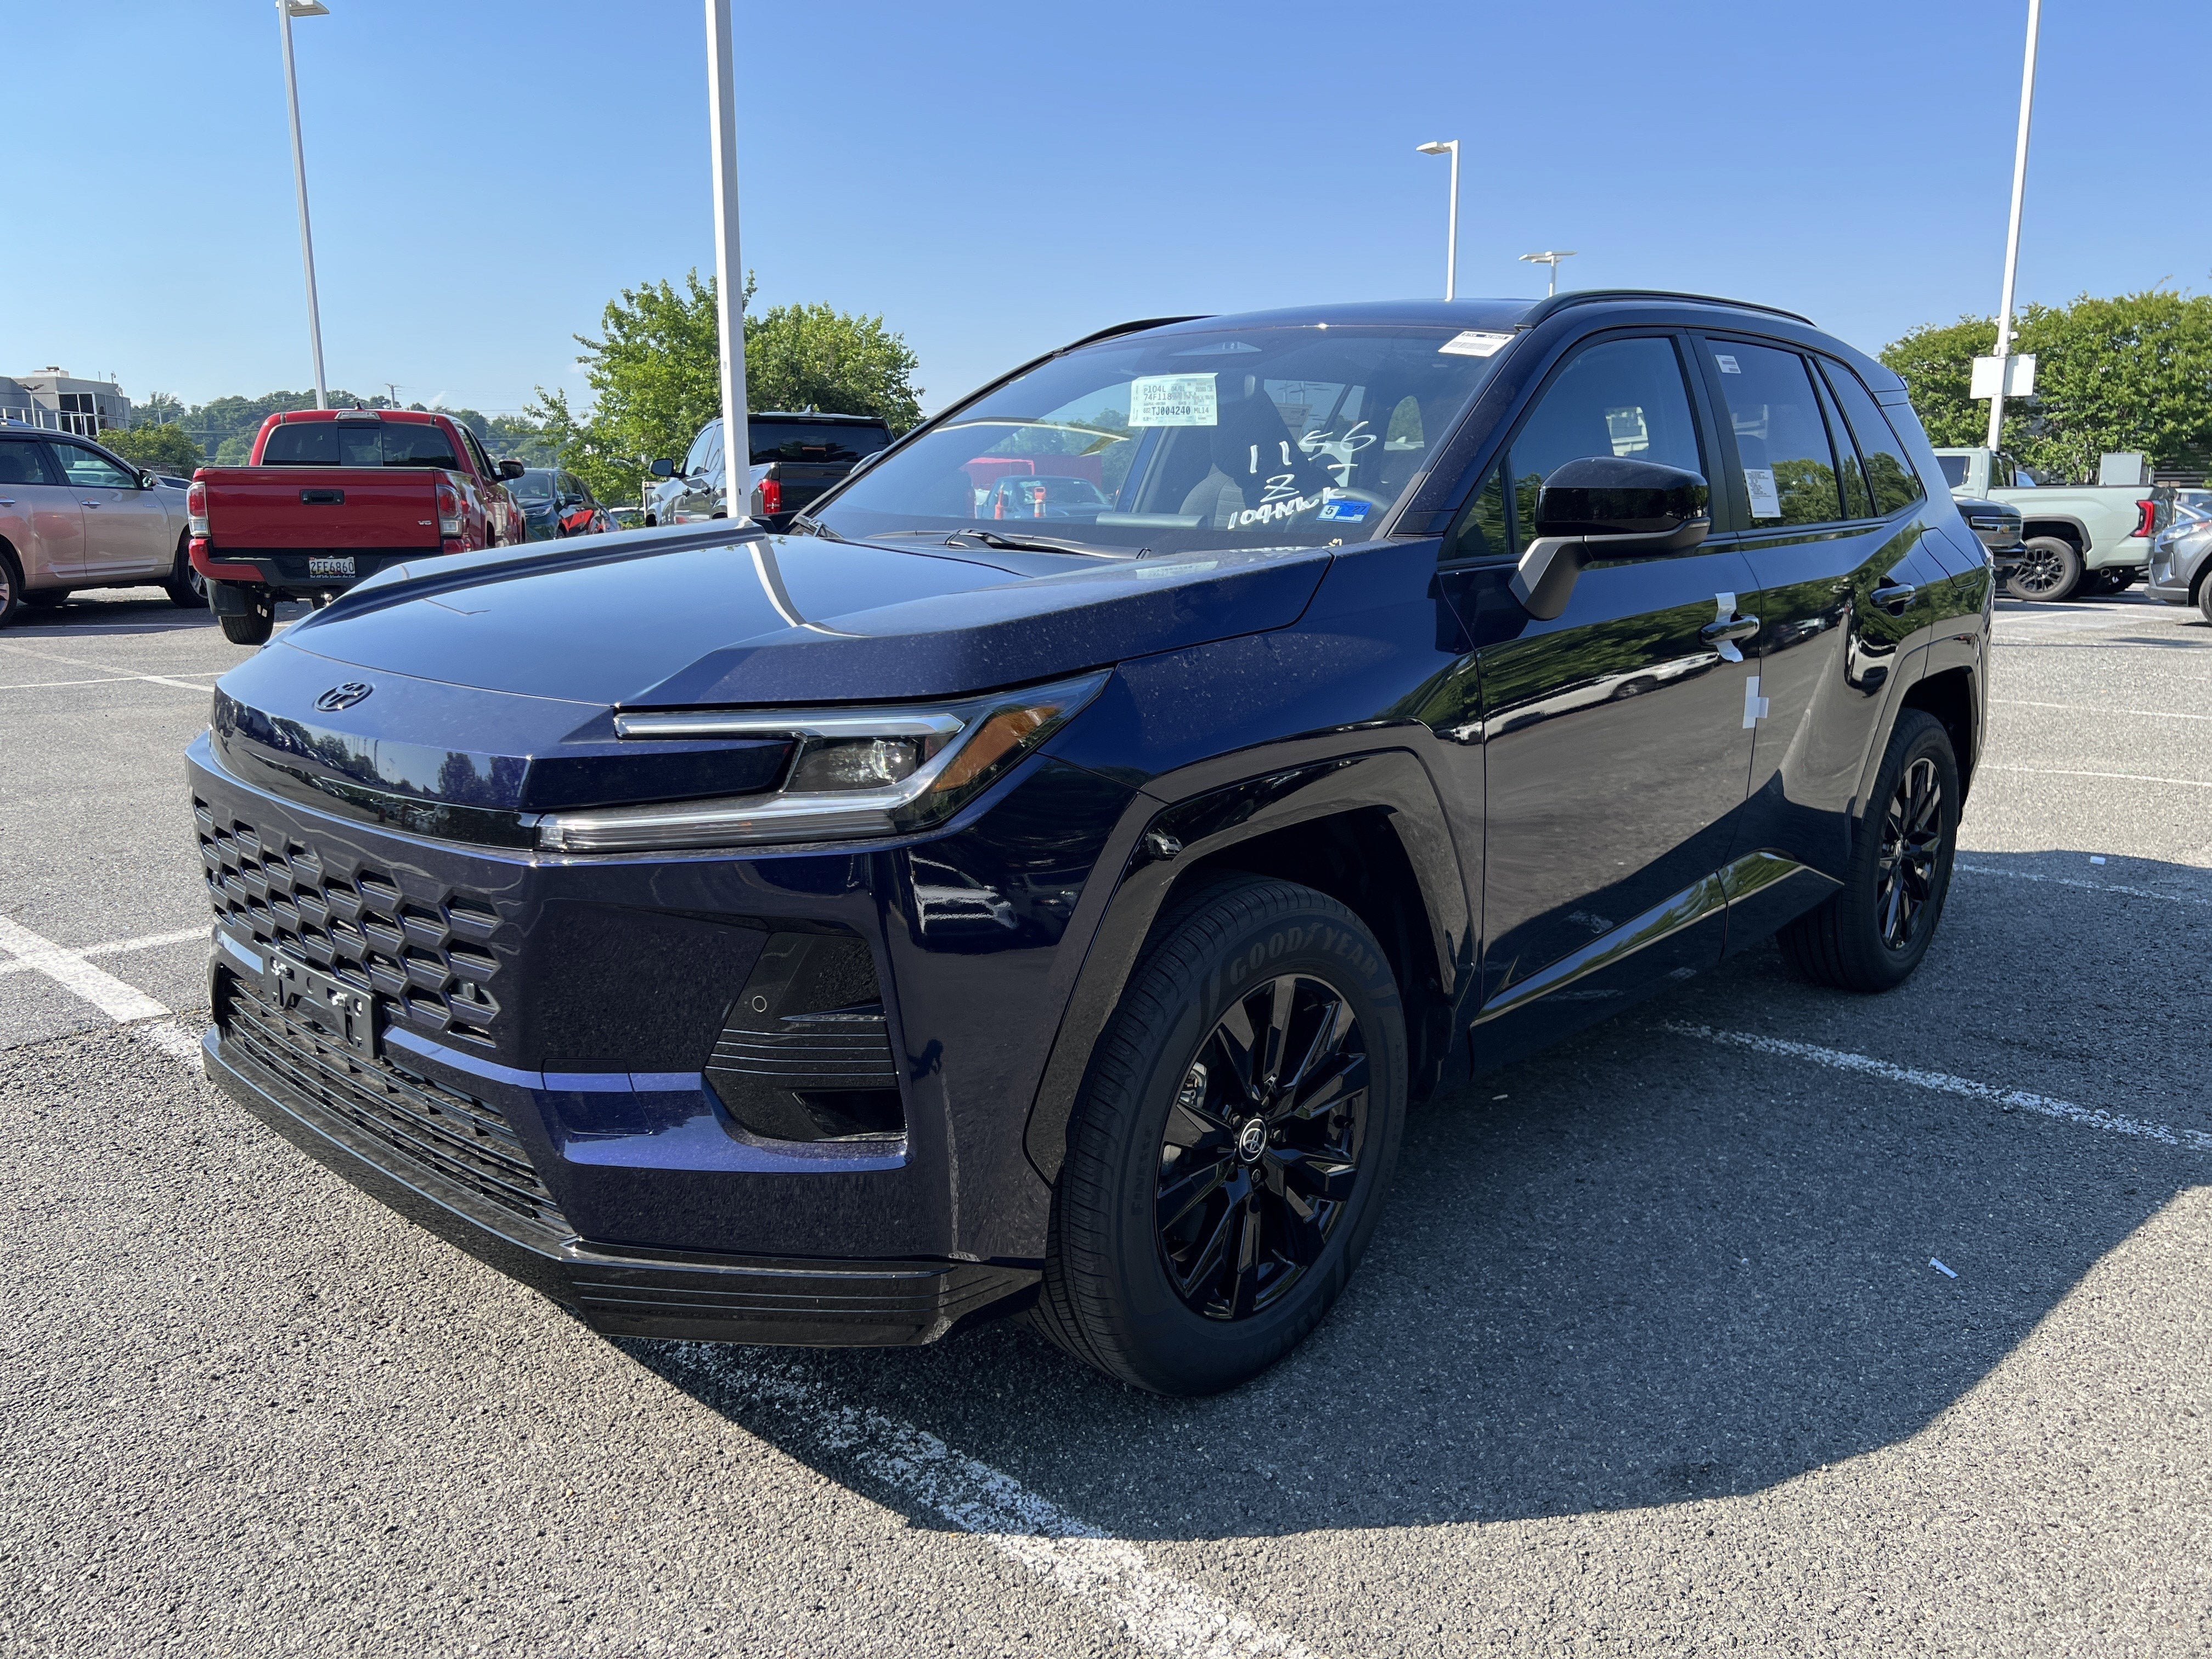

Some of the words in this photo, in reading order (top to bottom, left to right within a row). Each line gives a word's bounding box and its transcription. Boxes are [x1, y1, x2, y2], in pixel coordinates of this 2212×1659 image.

[1151, 406, 1190, 415] TJ004240
[1325, 506, 1335, 515] 5
[1229, 922, 1379, 985] GOODYEAR
